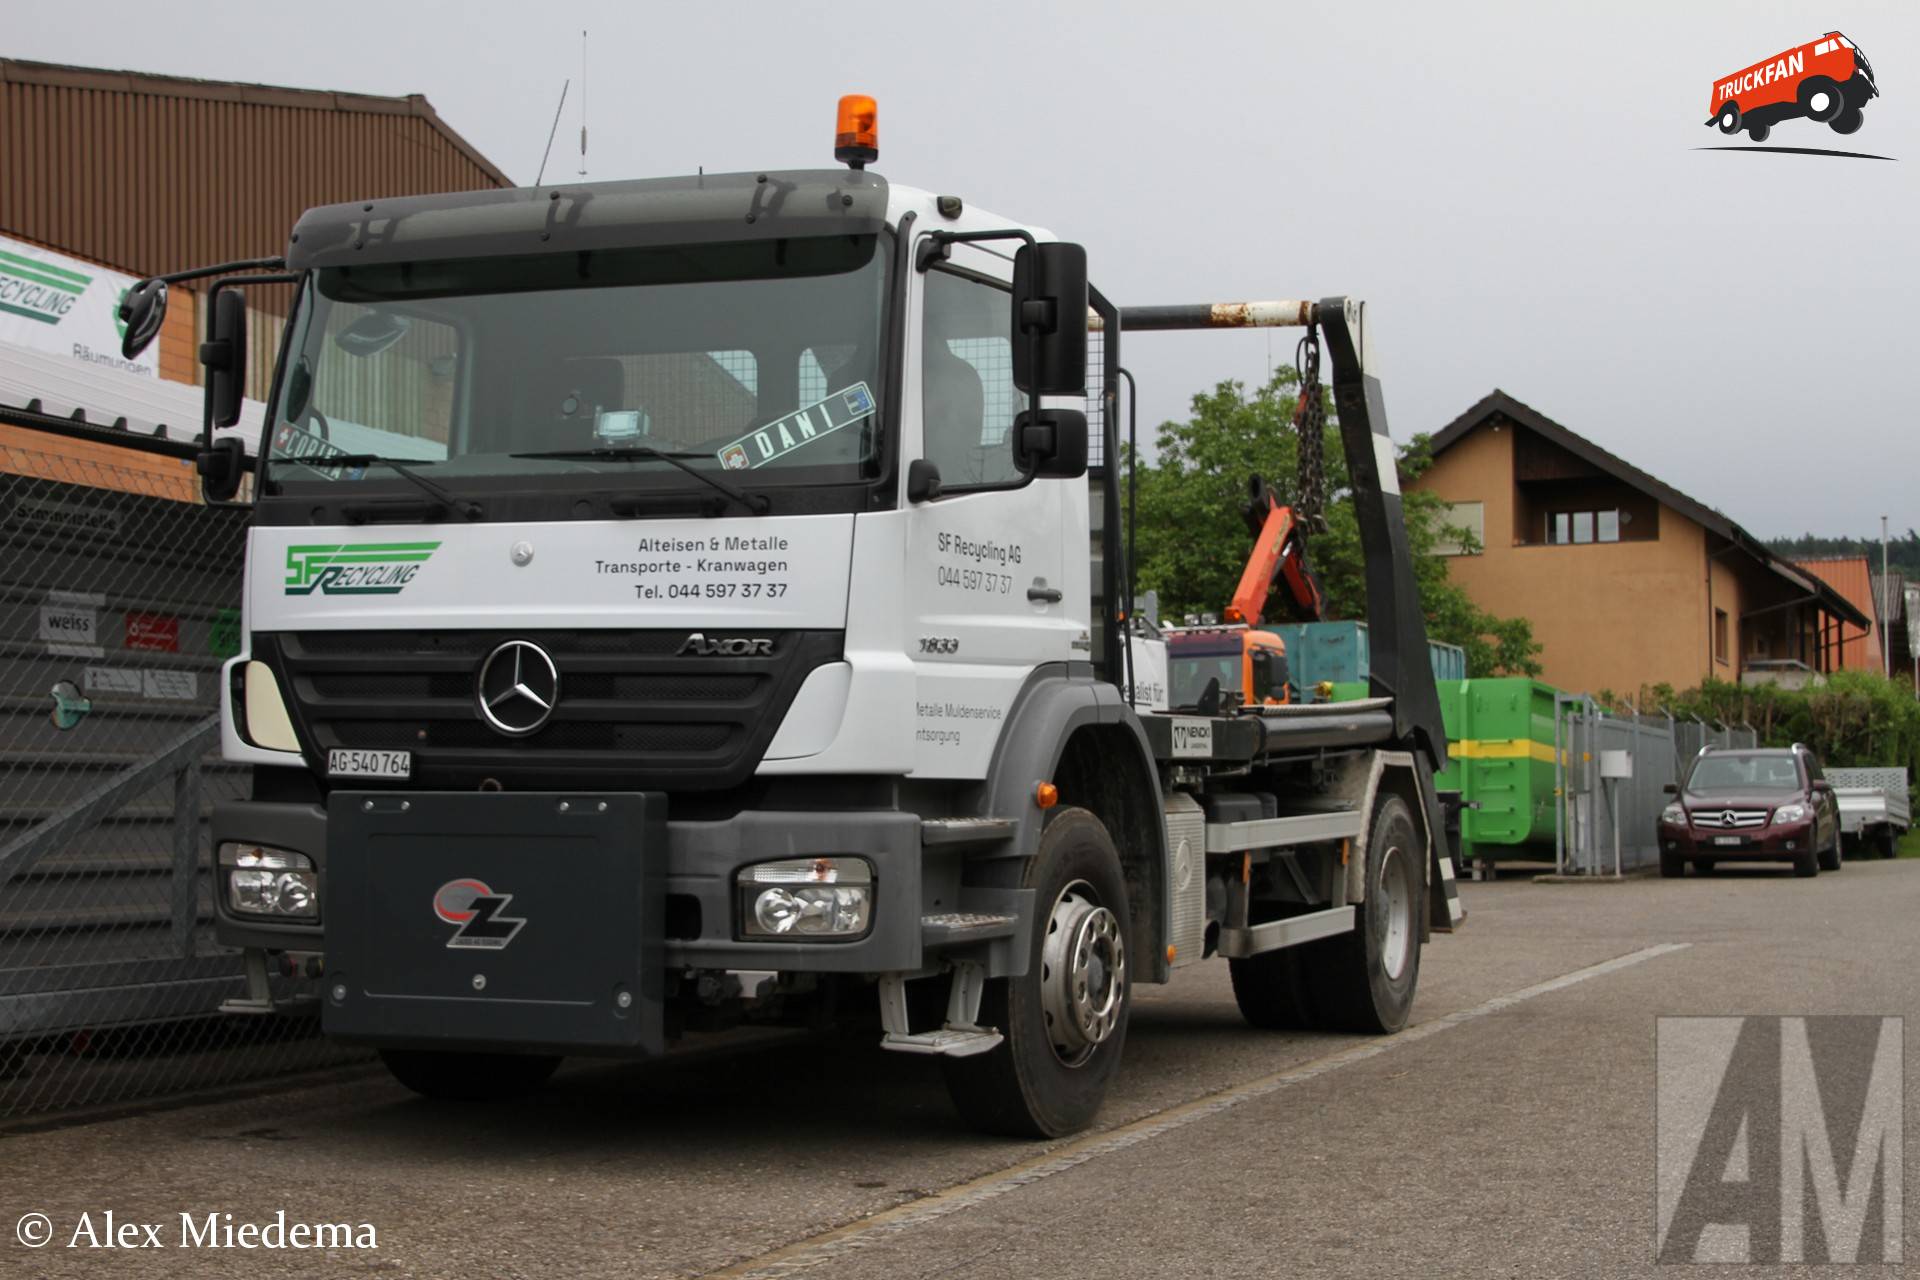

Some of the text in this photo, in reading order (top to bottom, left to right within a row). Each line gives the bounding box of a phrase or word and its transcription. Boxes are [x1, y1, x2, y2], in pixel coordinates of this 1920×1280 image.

[0, 276, 76, 315] CYCLING
[73, 342, 152, 376] Räumungen
[754, 404, 834, 459] DANI
[638, 536, 789, 552] Alteisen & Metalle
[938, 532, 1021, 567] SF Recycling AG
[595, 560, 681, 576] Transporte
[697, 558, 788, 575] Kranwagen
[938, 566, 1012, 594] 044 597 37 37
[634, 583, 788, 599] Tel. 044 597 37 37
[48, 613, 90, 632] weiss
[916, 729, 960, 746] ntsorgung
[329, 751, 347, 771] AG
